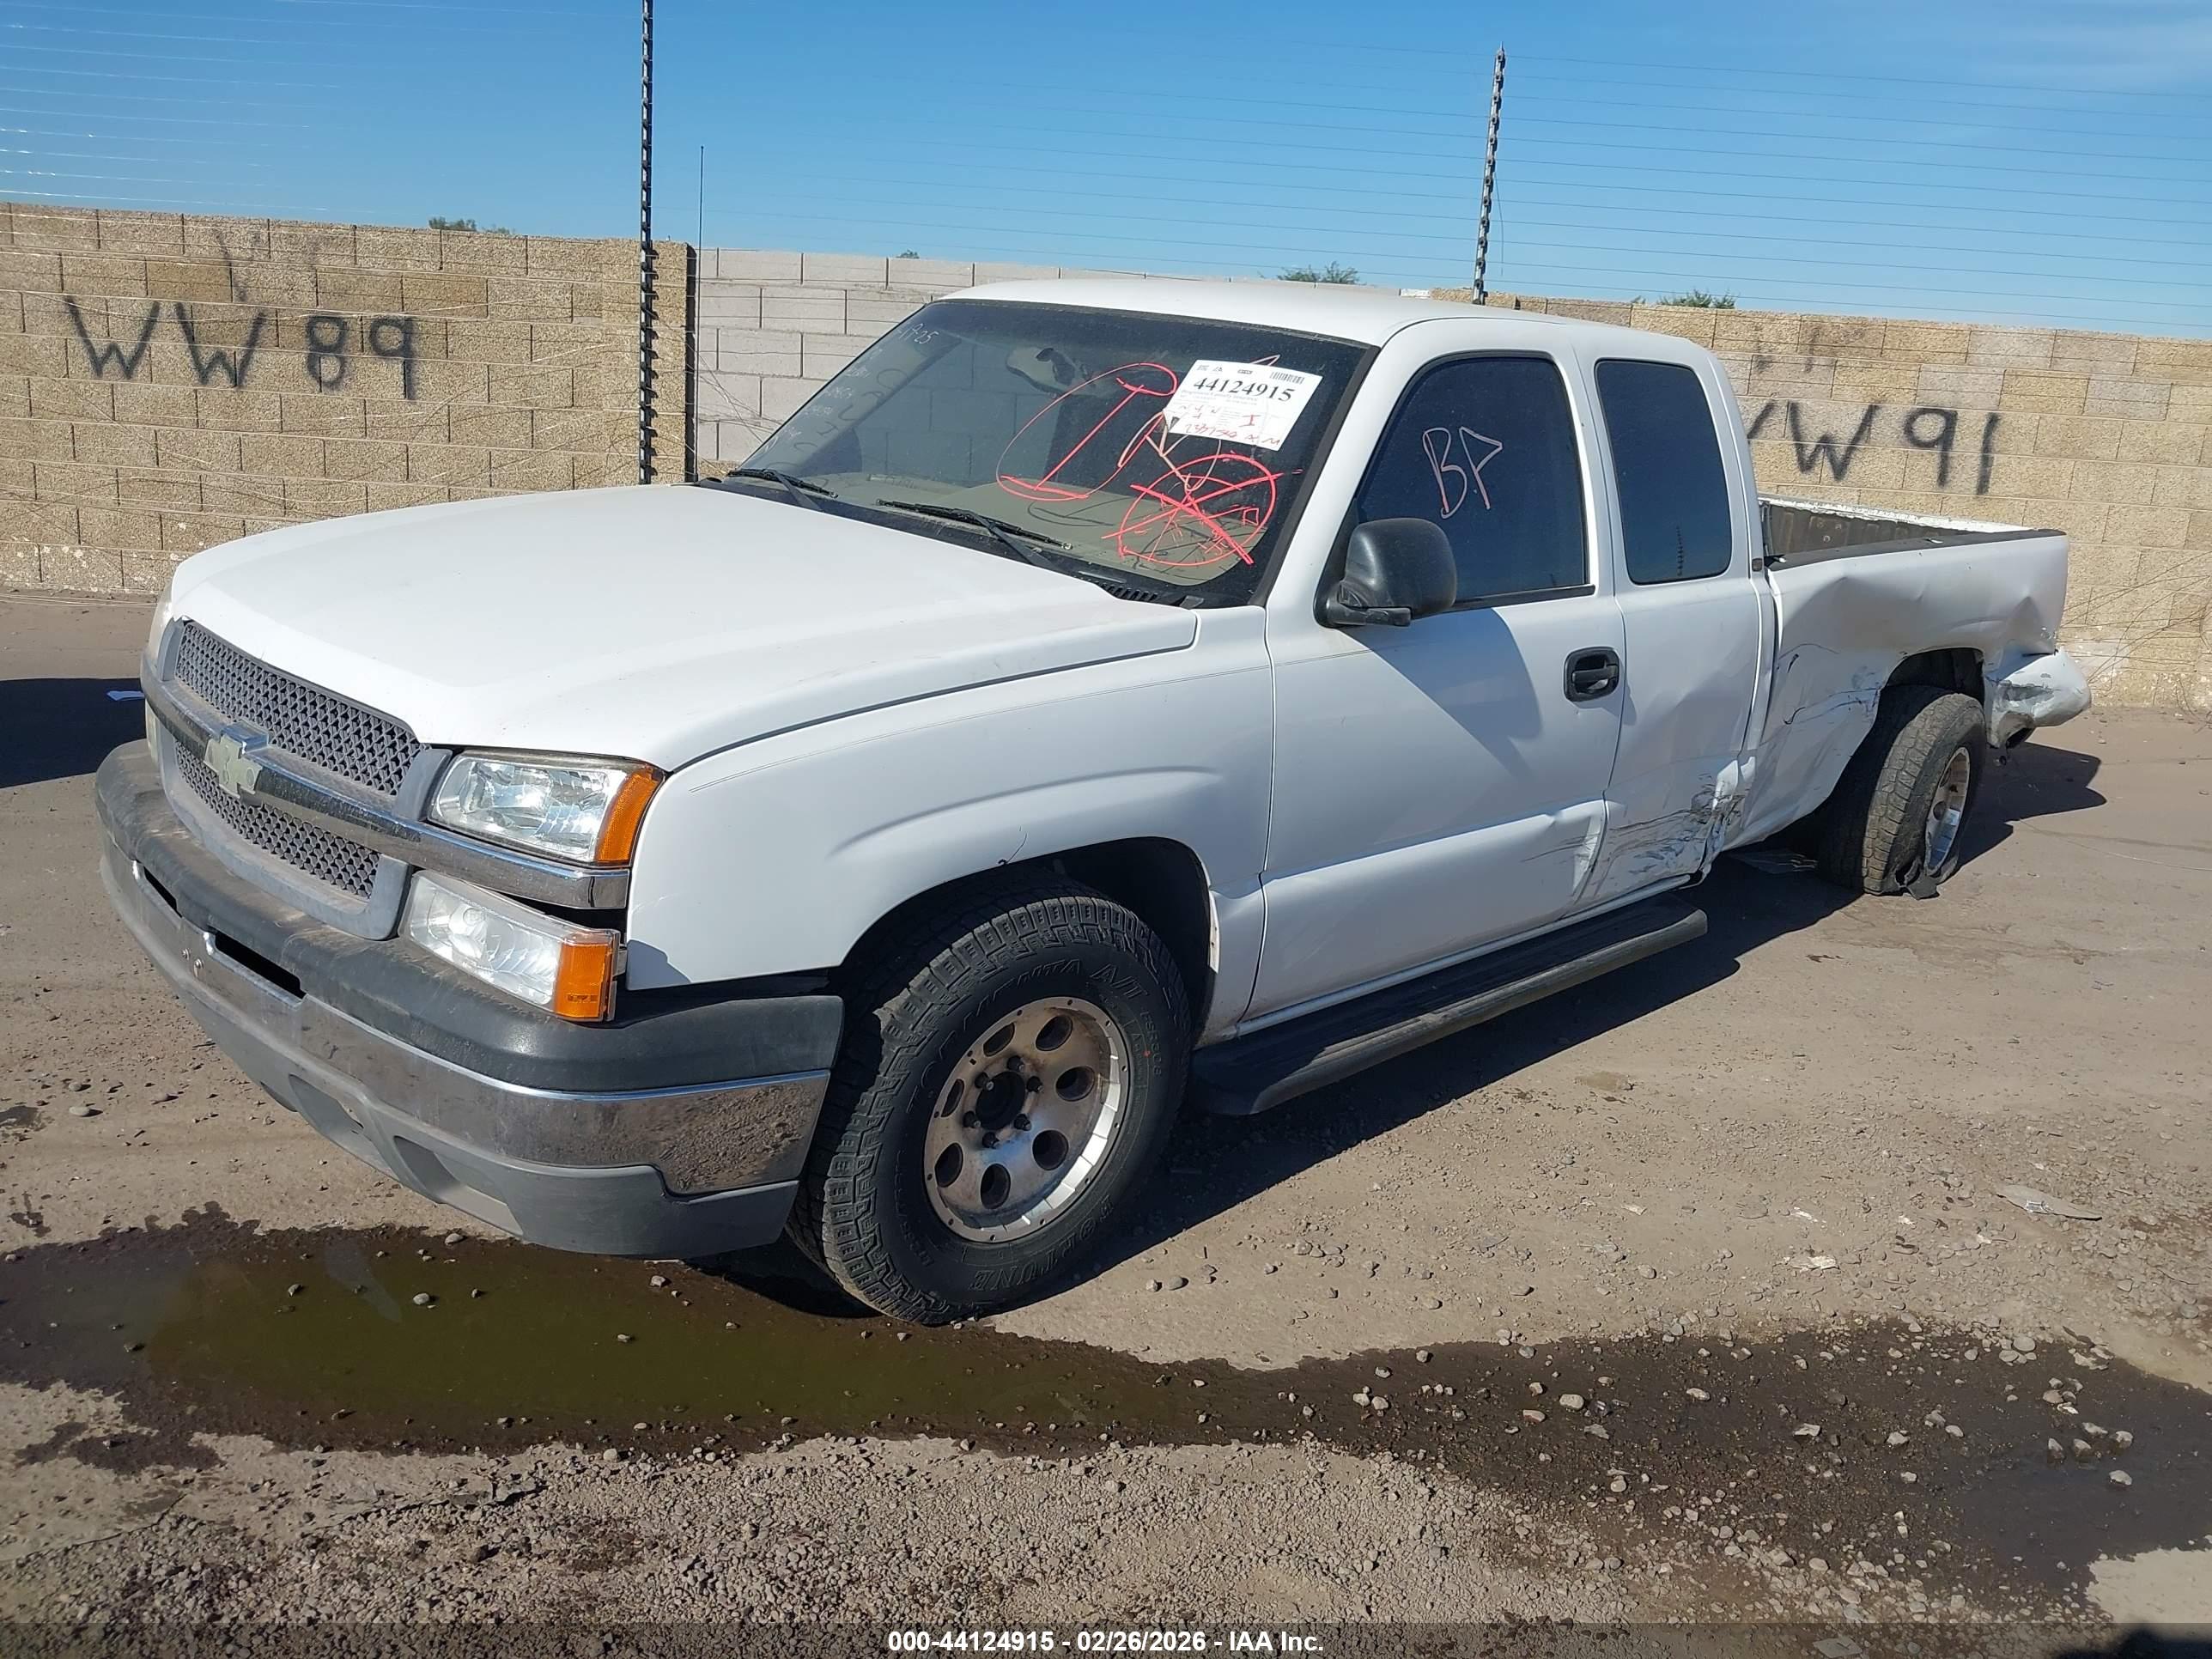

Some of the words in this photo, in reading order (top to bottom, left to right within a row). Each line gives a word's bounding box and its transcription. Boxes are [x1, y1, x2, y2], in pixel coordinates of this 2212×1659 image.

[304, 311, 421, 401] 89
[1194, 376, 1296, 402] 44124915
[1904, 405, 2002, 496] 91
